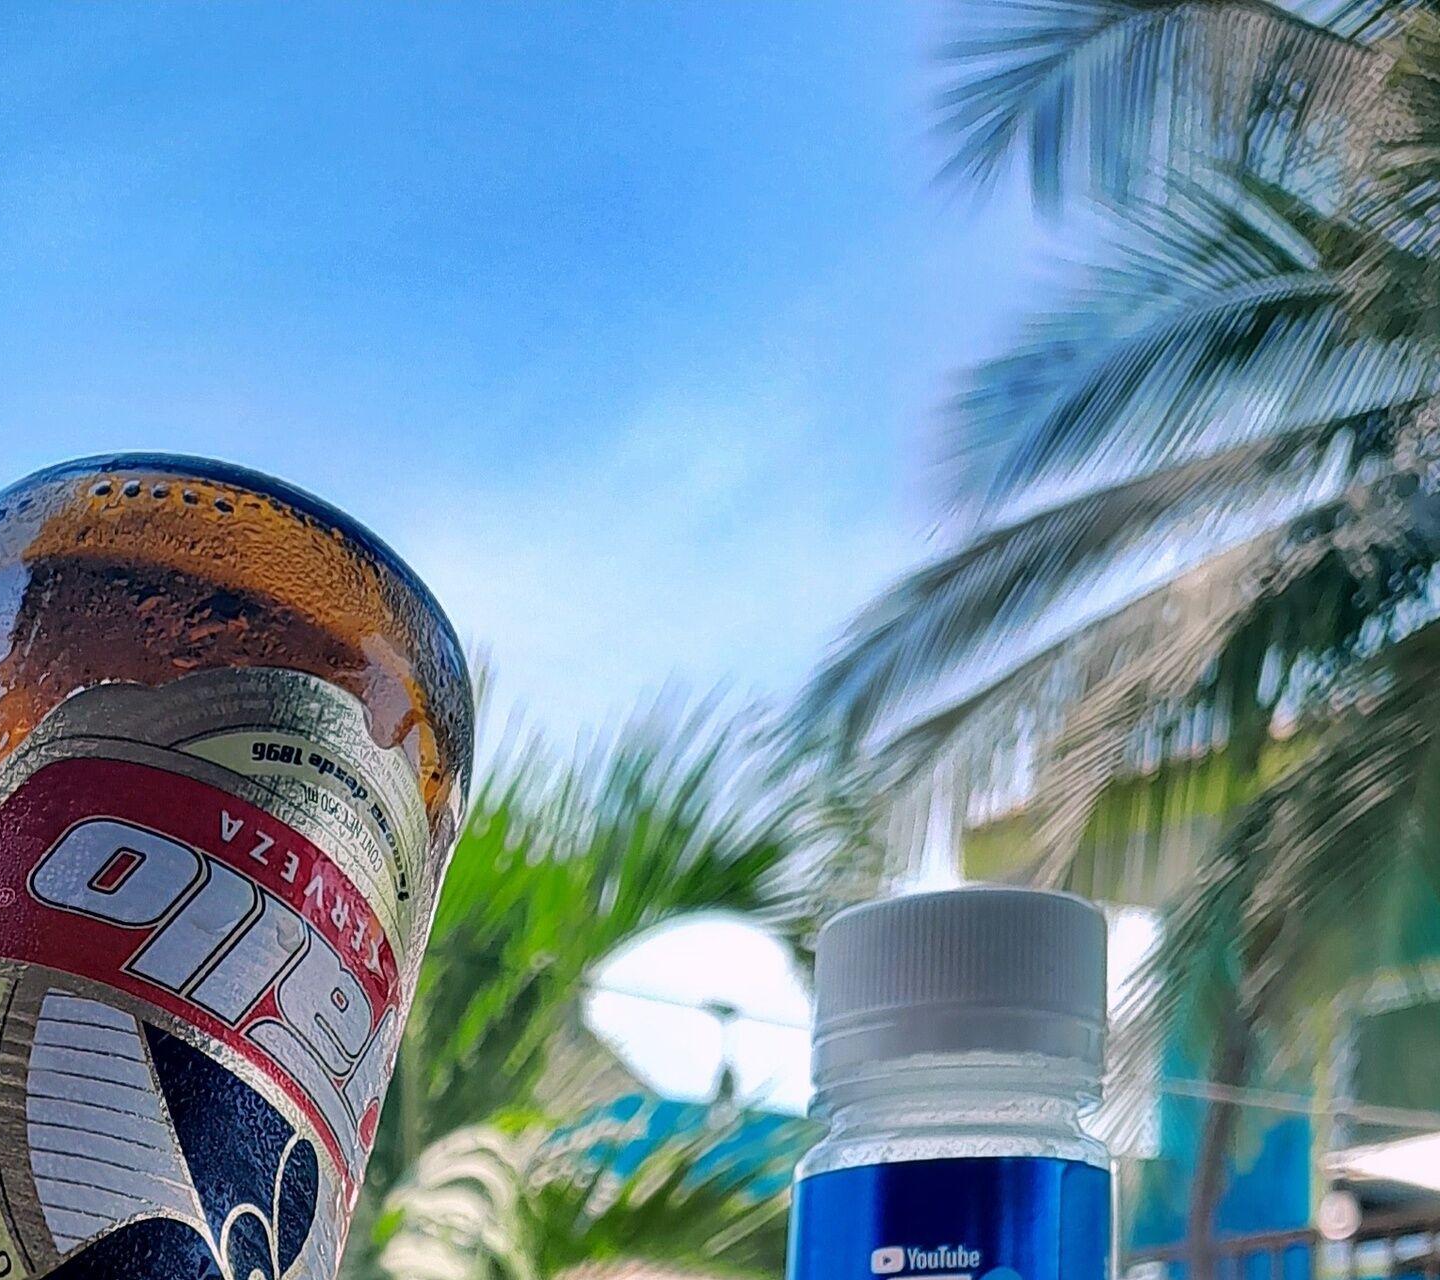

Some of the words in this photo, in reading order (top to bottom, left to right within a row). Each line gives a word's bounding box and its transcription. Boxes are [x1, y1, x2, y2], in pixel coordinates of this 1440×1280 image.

[251, 741, 304, 767] 1896
[308, 753, 368, 802] desde
[907, 1244, 980, 1270] YouTube
